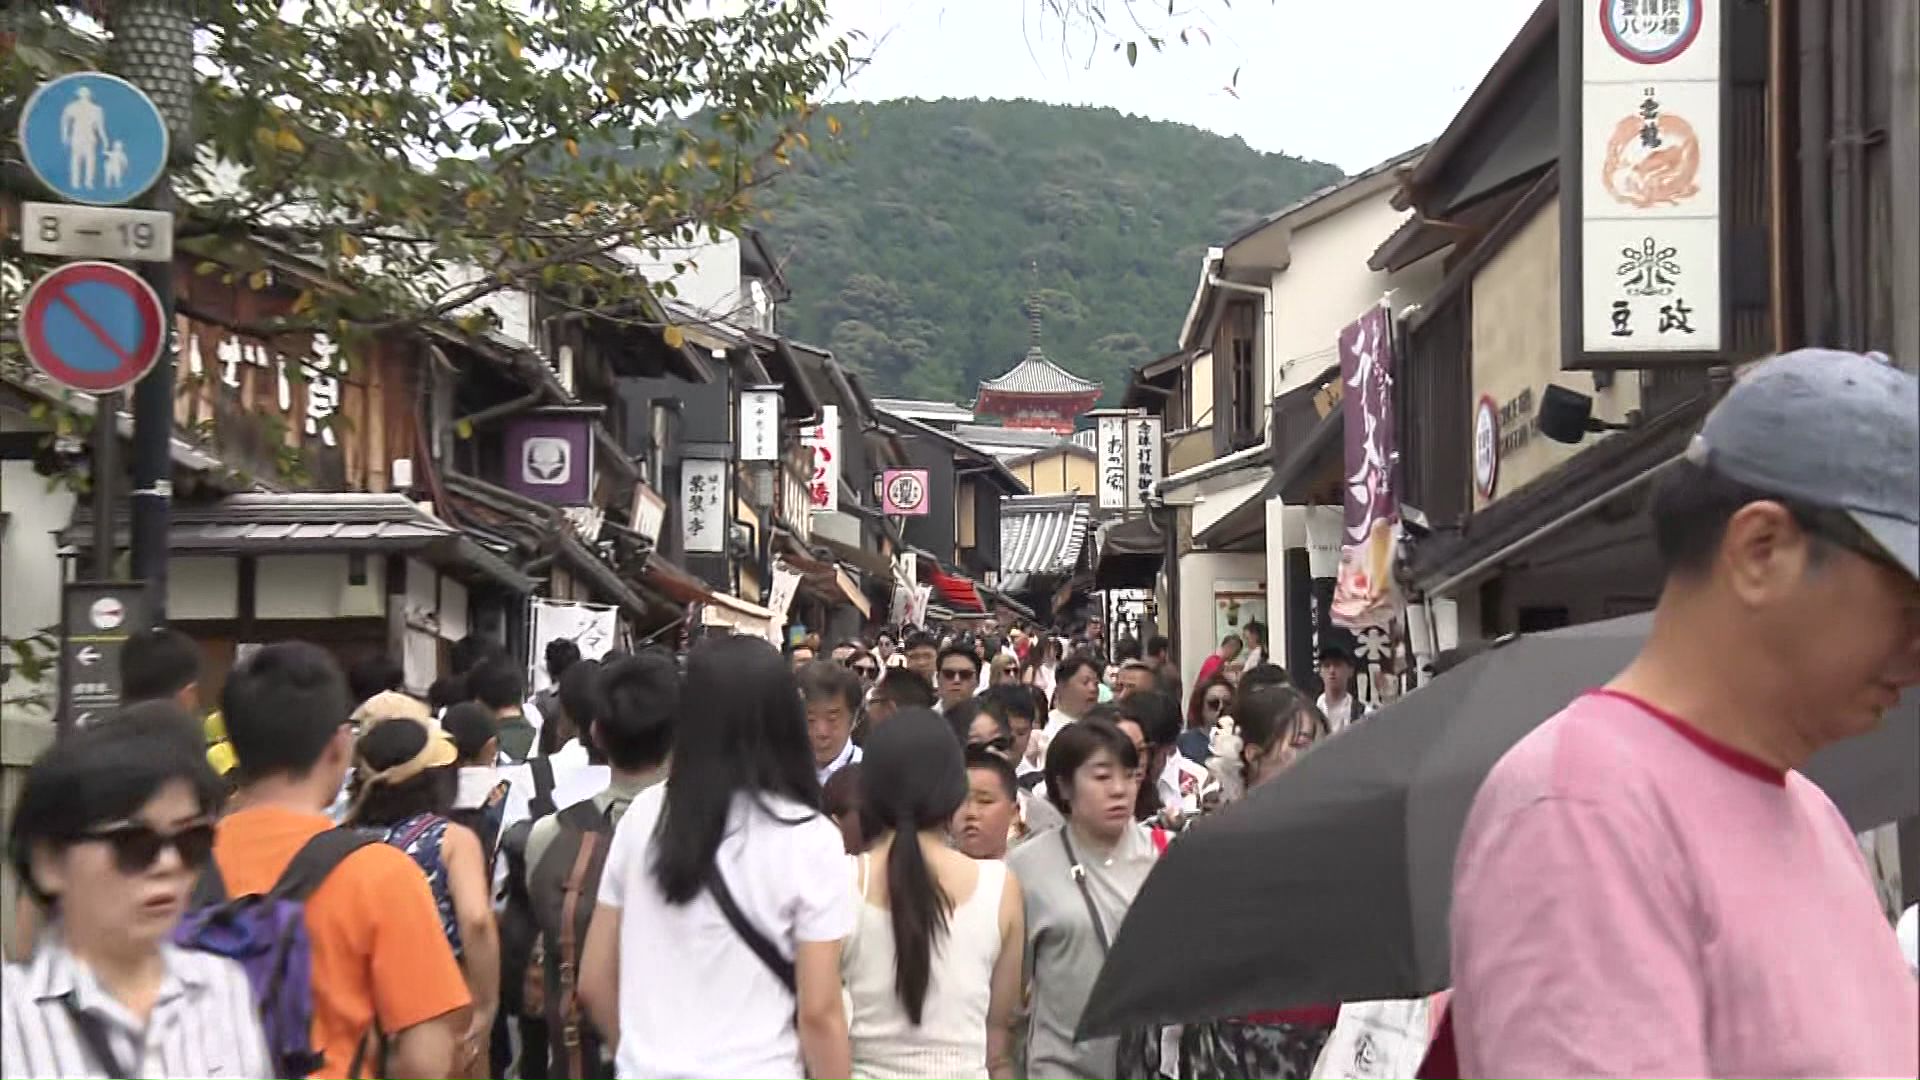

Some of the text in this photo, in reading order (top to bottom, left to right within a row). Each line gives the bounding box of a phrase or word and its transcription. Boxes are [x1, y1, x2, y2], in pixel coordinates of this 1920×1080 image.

[1618, 17, 1681, 35] 八ツ橋
[39, 216, 60, 243] 8
[119, 222, 155, 248] 19
